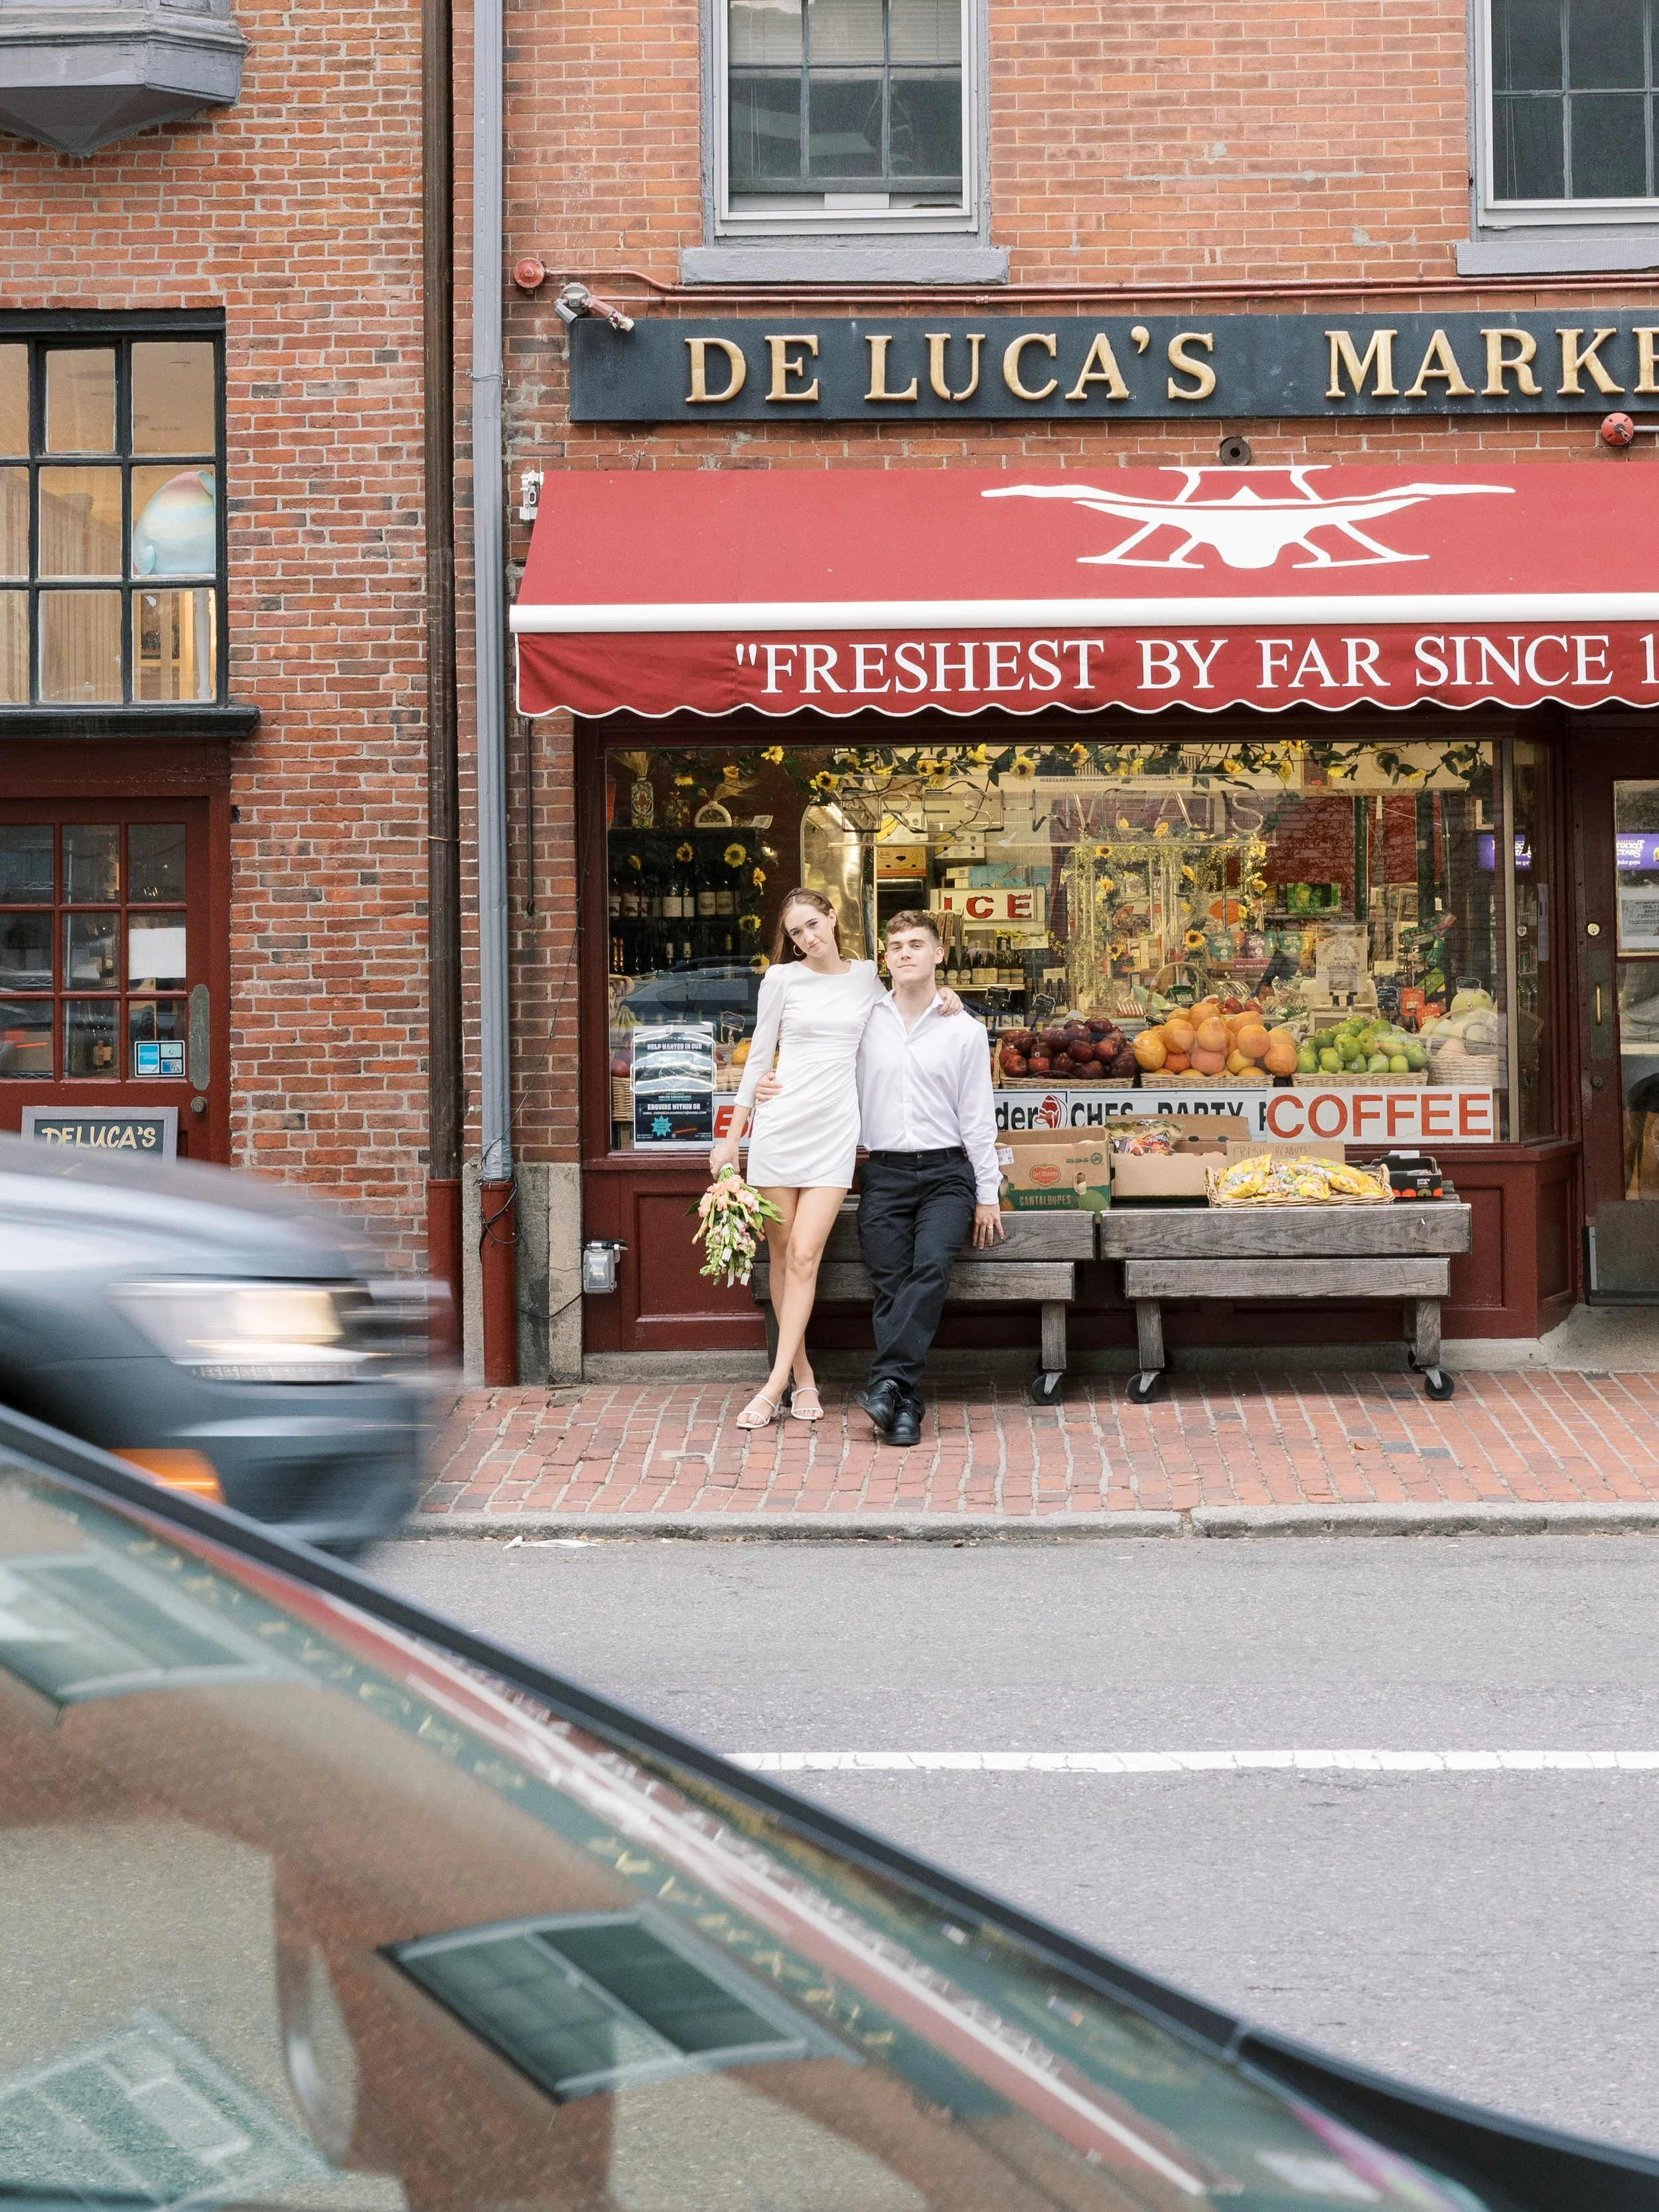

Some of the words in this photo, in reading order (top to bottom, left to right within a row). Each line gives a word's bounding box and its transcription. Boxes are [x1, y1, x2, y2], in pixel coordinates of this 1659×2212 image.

[685, 336, 818, 403] DE
[865, 327, 1216, 400] LUCA'S
[735, 640, 1104, 694] "FRESHEST
[1135, 639, 1229, 689] BY
[1255, 638, 1391, 688] FAR
[1414, 634, 1613, 686] SINCE
[943, 892, 1032, 919] ICE
[1266, 1093, 1492, 1139] COFFEE
[41, 1126, 157, 1149] DELUCA'S
[1019, 1195, 1072, 1206] CANTALOUPES
